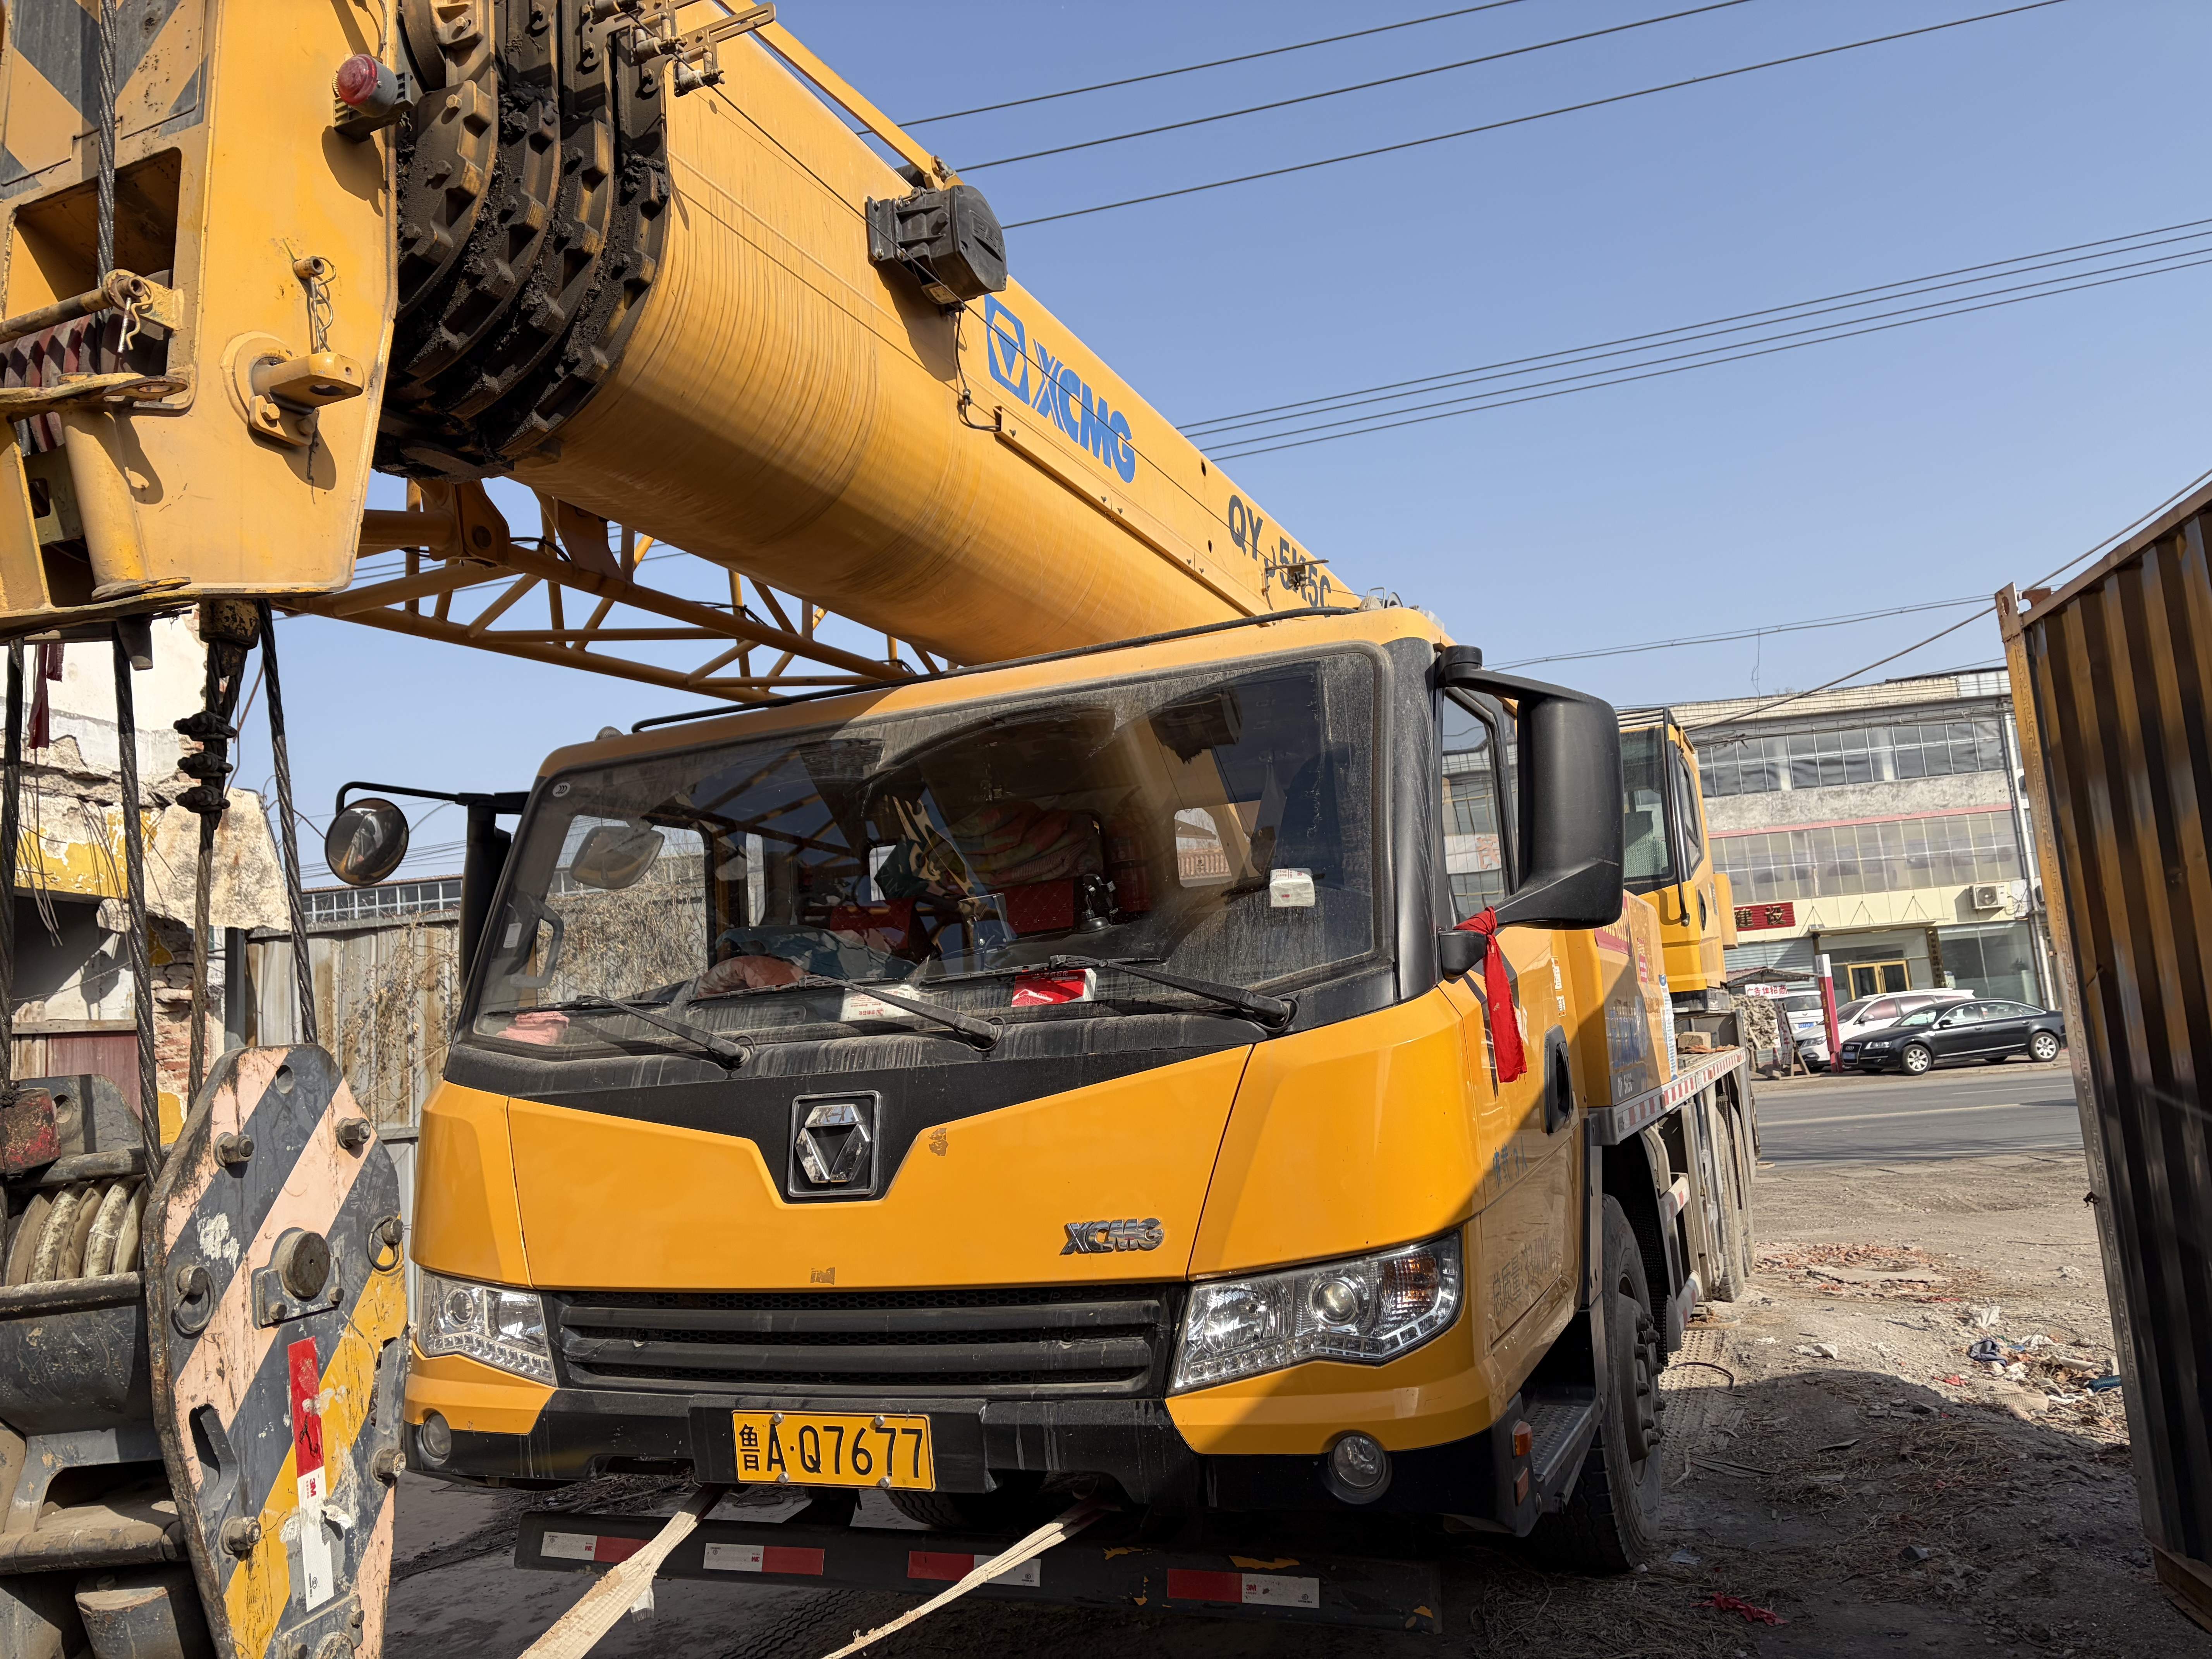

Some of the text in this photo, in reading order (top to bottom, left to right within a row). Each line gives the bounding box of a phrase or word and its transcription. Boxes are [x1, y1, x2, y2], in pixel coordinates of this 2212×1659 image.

[1032, 338, 1135, 483] XCMG
[1747, 984, 1787, 996] 广告位招商
[1059, 1218, 1164, 1255] XCMG
[739, 1424, 923, 1479] 鲁A·Q7677
[310, 1477, 316, 1498] 3M
